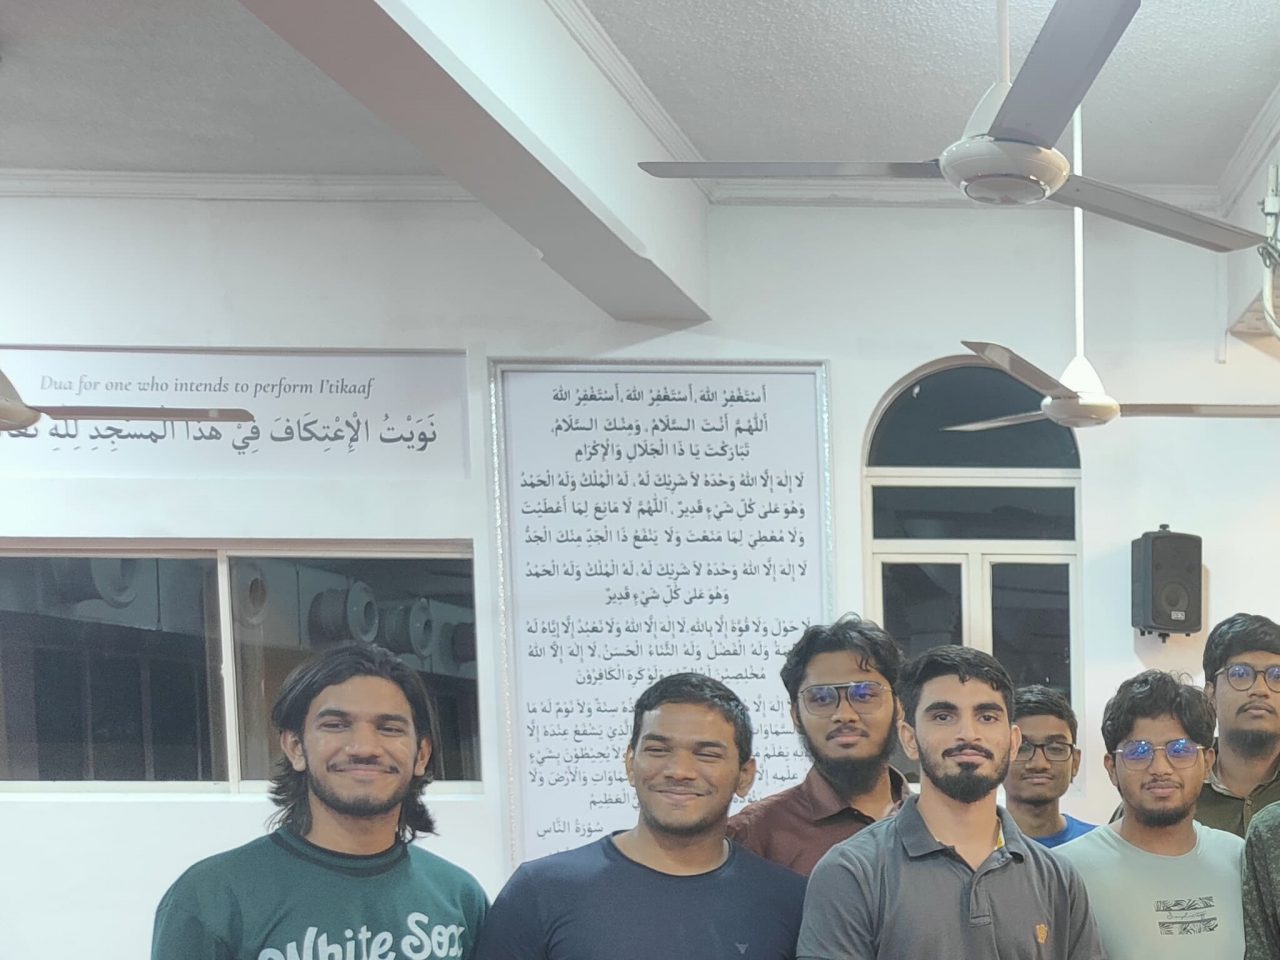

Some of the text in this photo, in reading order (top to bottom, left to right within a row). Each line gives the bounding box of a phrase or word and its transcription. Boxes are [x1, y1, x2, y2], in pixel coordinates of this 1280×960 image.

[40, 375, 73, 392] Dua
[77, 374, 101, 395] for
[104, 380, 132, 393] one
[137, 375, 169, 393] who
[174, 376, 230, 394] intends
[234, 379, 249, 394] to
[253, 376, 314, 399] perform
[401, 912, 465, 960] Sox
